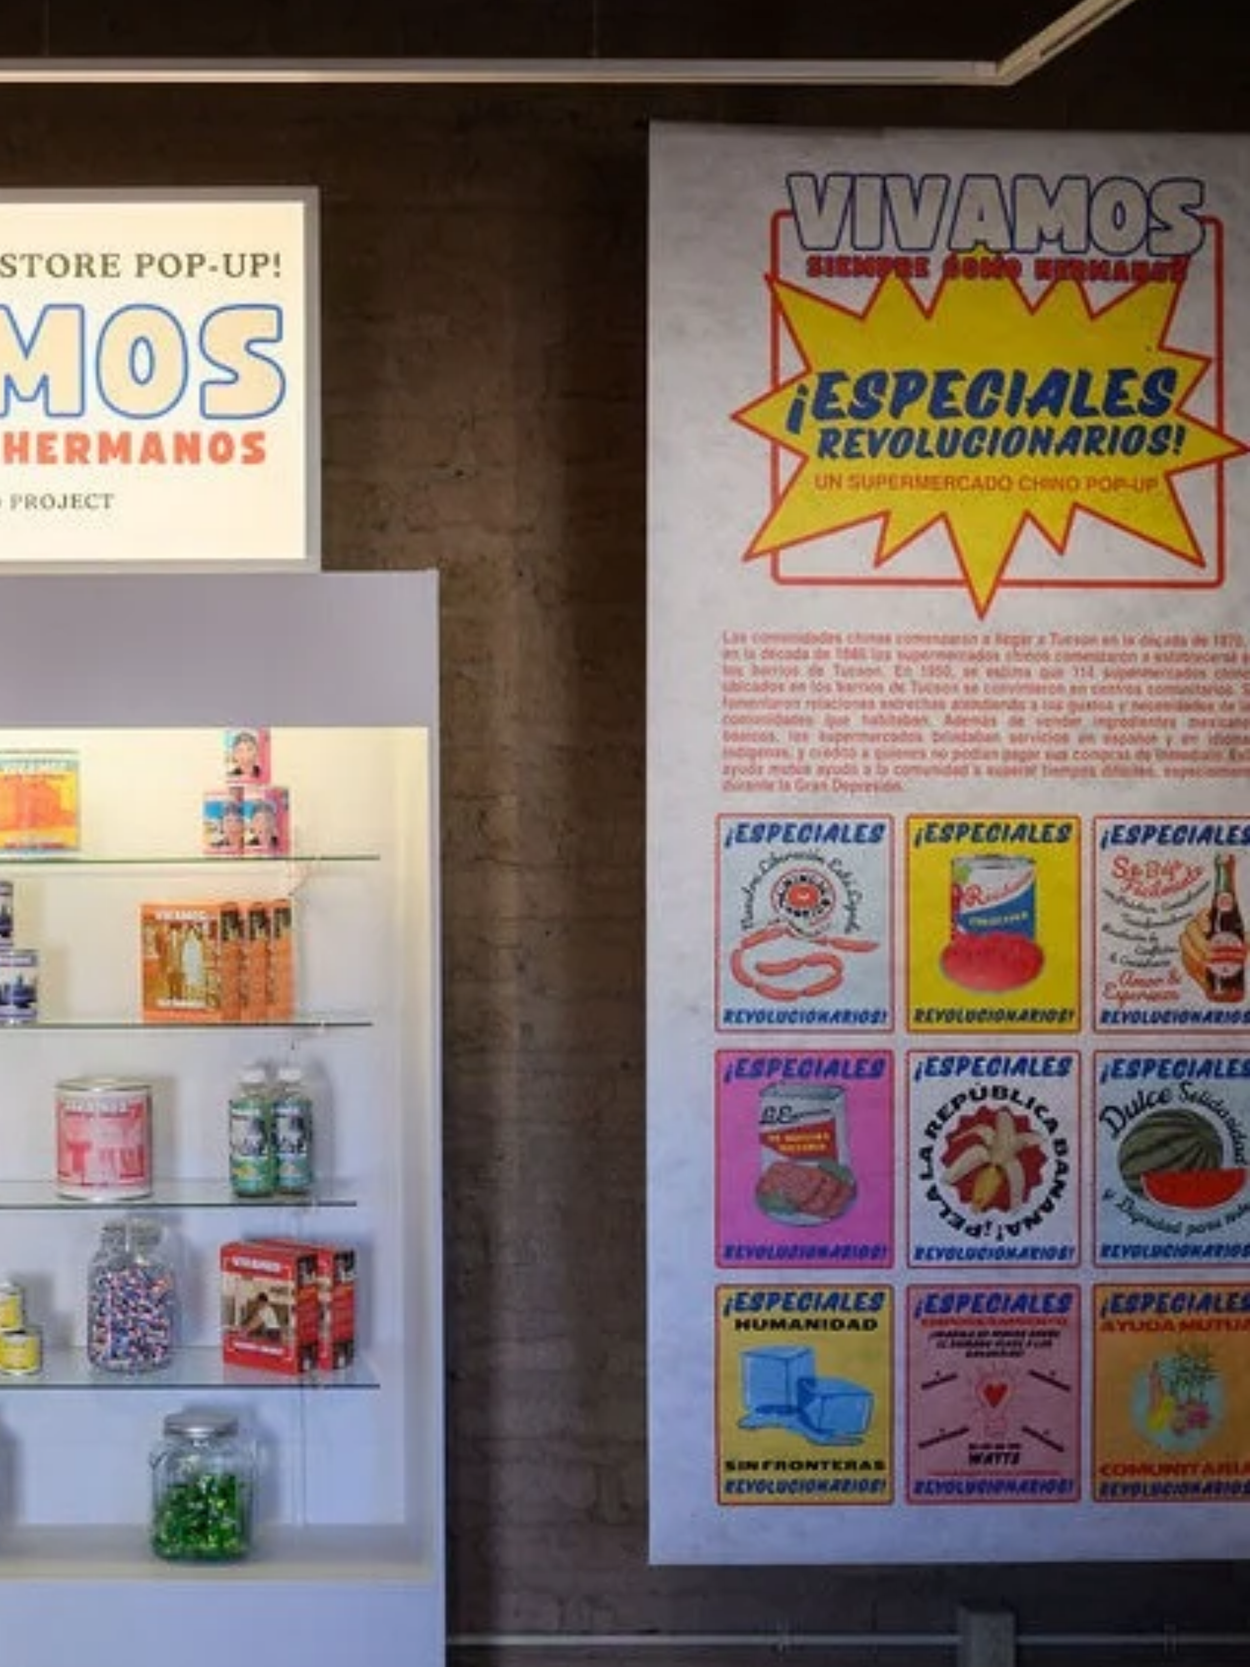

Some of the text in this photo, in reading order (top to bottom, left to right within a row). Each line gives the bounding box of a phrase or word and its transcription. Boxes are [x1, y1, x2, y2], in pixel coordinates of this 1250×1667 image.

[786, 172, 1206, 256] VIVAMOS
[134, 252, 282, 278] POP-UP!
[806, 254, 1187, 282] SIEMPRE COMO HERMANOS
[786, 368, 1178, 434] ¡ESPECIALES
[3, 431, 267, 466] HERMANOS
[816, 424, 1185, 459] REVOLUCIONARIOS!
[815, 474, 1157, 493] UN SUPERMERCADO CHINO POP-UP
[9, 492, 115, 510] PROJECT
[724, 823, 886, 848] ¡ESPECIALES
[914, 823, 1072, 846] ¡ESPECIALES
[722, 1009, 887, 1025] REVOLUCIONARIOS!
[913, 1008, 1076, 1025] REVOLUCIONARIOS!
[724, 1057, 886, 1083] ¡ESPECIALES
[915, 1056, 1073, 1083] ¡ESPECIALES
[914, 1245, 1075, 1261] REVOLUCIONARIOS!
[723, 1291, 886, 1318] ¡ESPECIALES
[914, 1292, 1073, 1319] ¡ESPECIALES
[734, 1318, 879, 1332] HUMANIDAD
[1100, 1319, 1175, 1332] AYUDA
[762, 1459, 885, 1472] FRONTERAS
